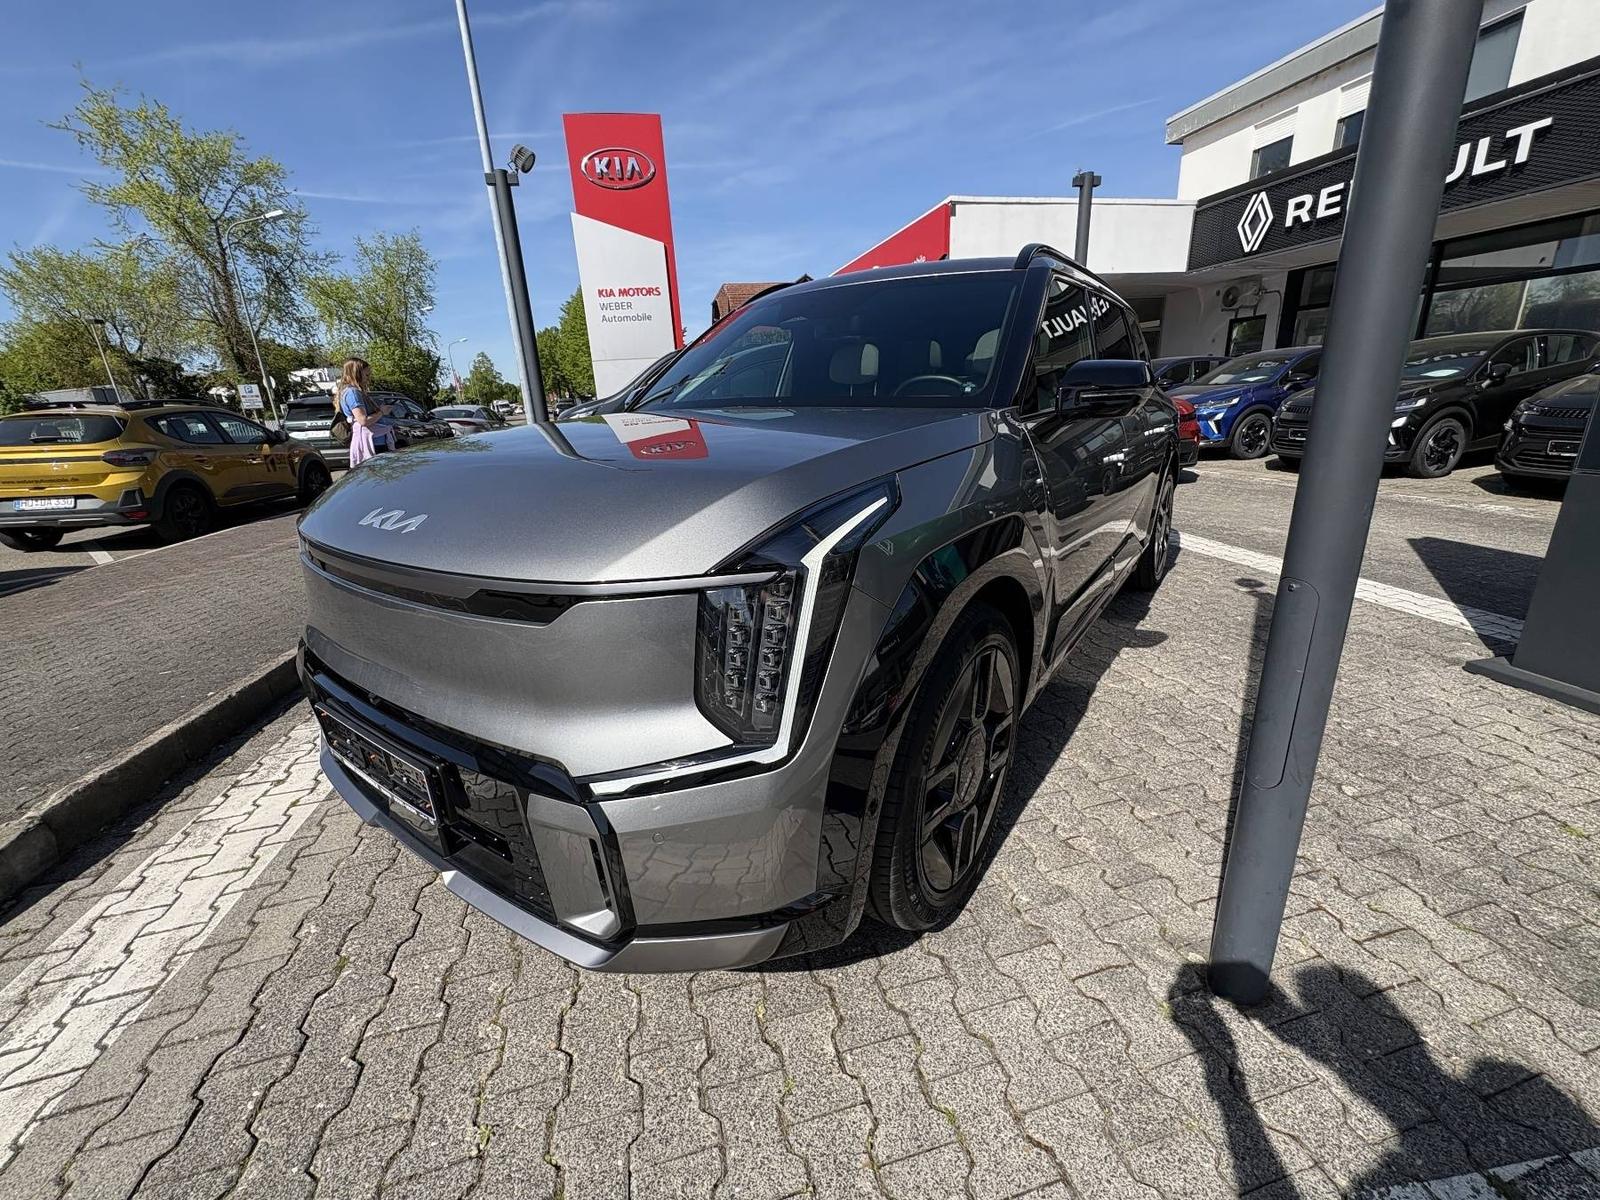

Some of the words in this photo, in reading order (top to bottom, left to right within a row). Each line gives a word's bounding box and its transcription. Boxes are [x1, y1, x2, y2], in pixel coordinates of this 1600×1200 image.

[593, 156, 643, 180] KIA
[1285, 116, 1553, 227] REULT
[597, 288, 616, 298] KIA
[618, 287, 661, 297] MOTORS
[599, 301, 633, 311] WEBER
[601, 313, 653, 323] Automobile
[358, 506, 429, 534] KIA
